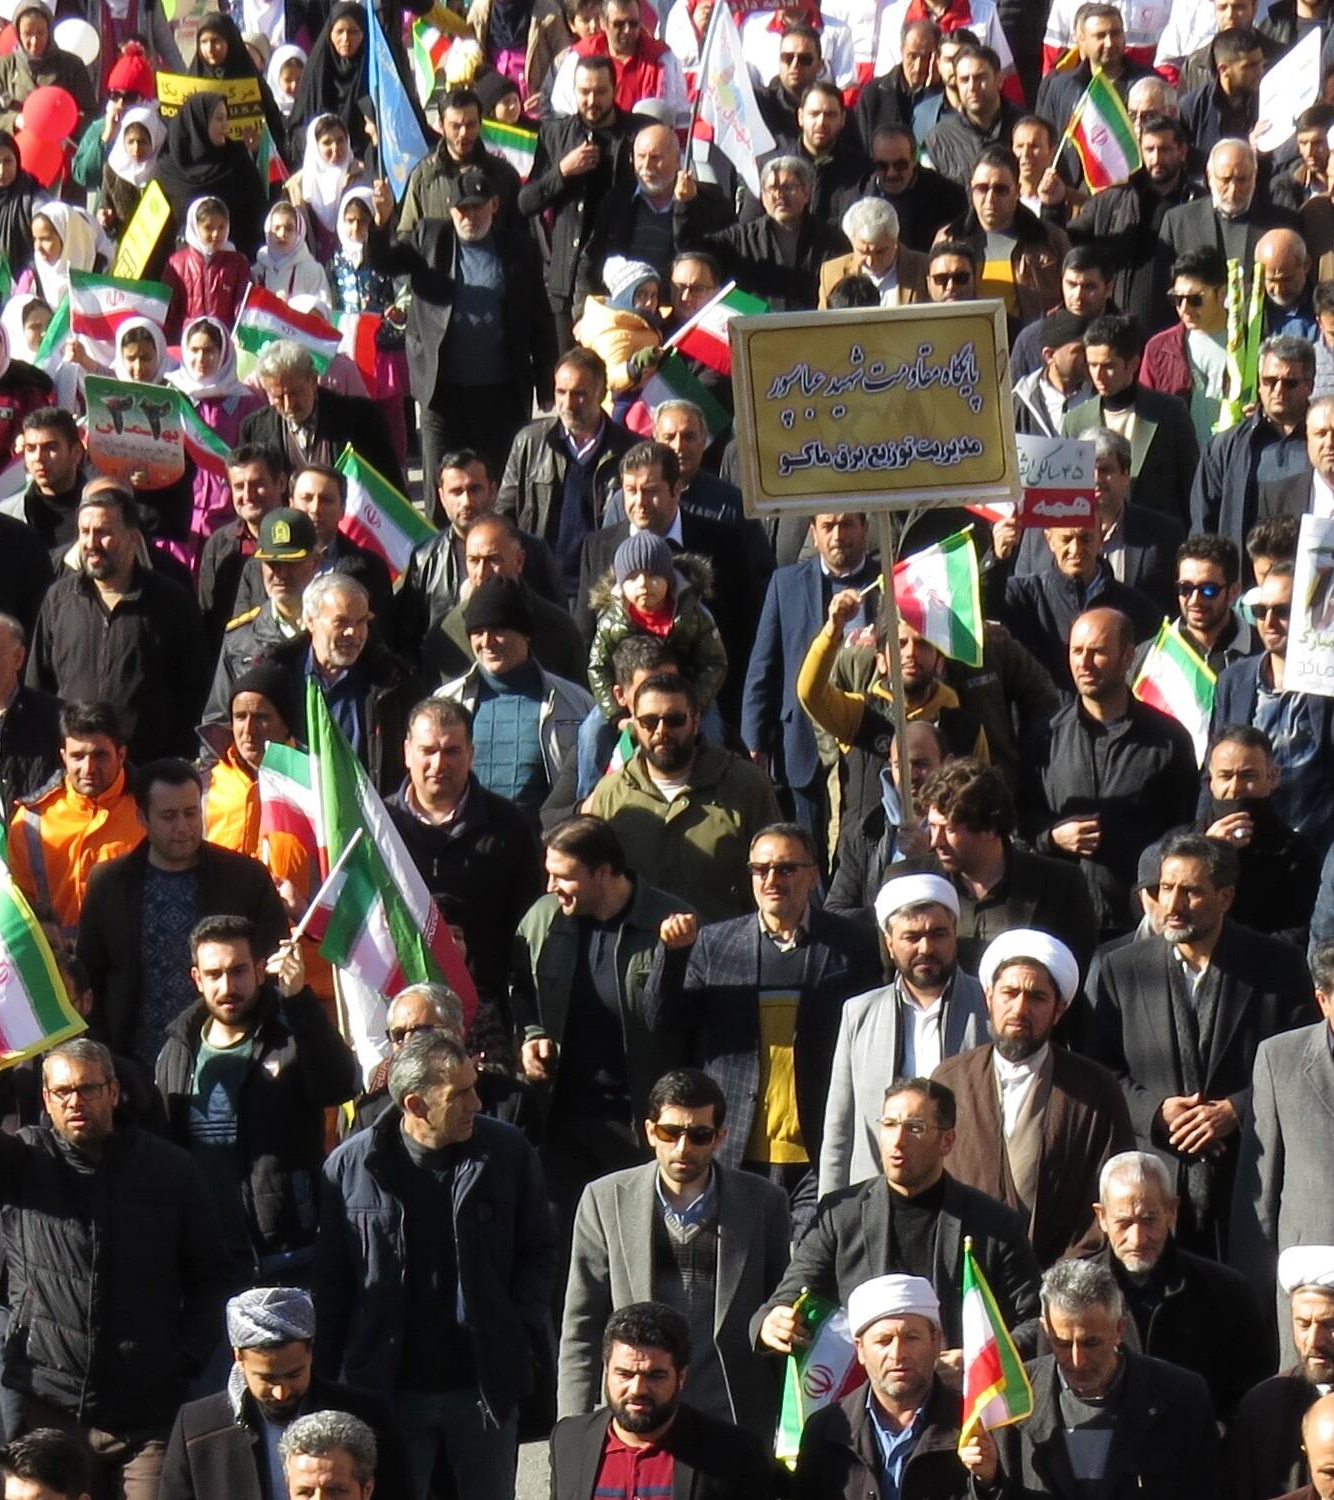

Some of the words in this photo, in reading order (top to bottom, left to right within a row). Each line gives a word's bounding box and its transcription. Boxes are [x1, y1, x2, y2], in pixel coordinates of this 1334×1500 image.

[823, 346, 865, 417] شهید
[864, 345, 939, 392] مقاومت
[105, 394, 172, 441] ۲۲
[779, 441, 831, 476] ماکو
[832, 444, 867, 472] برق
[867, 436, 915, 471] توزیع
[916, 436, 983, 466] مدیریت
